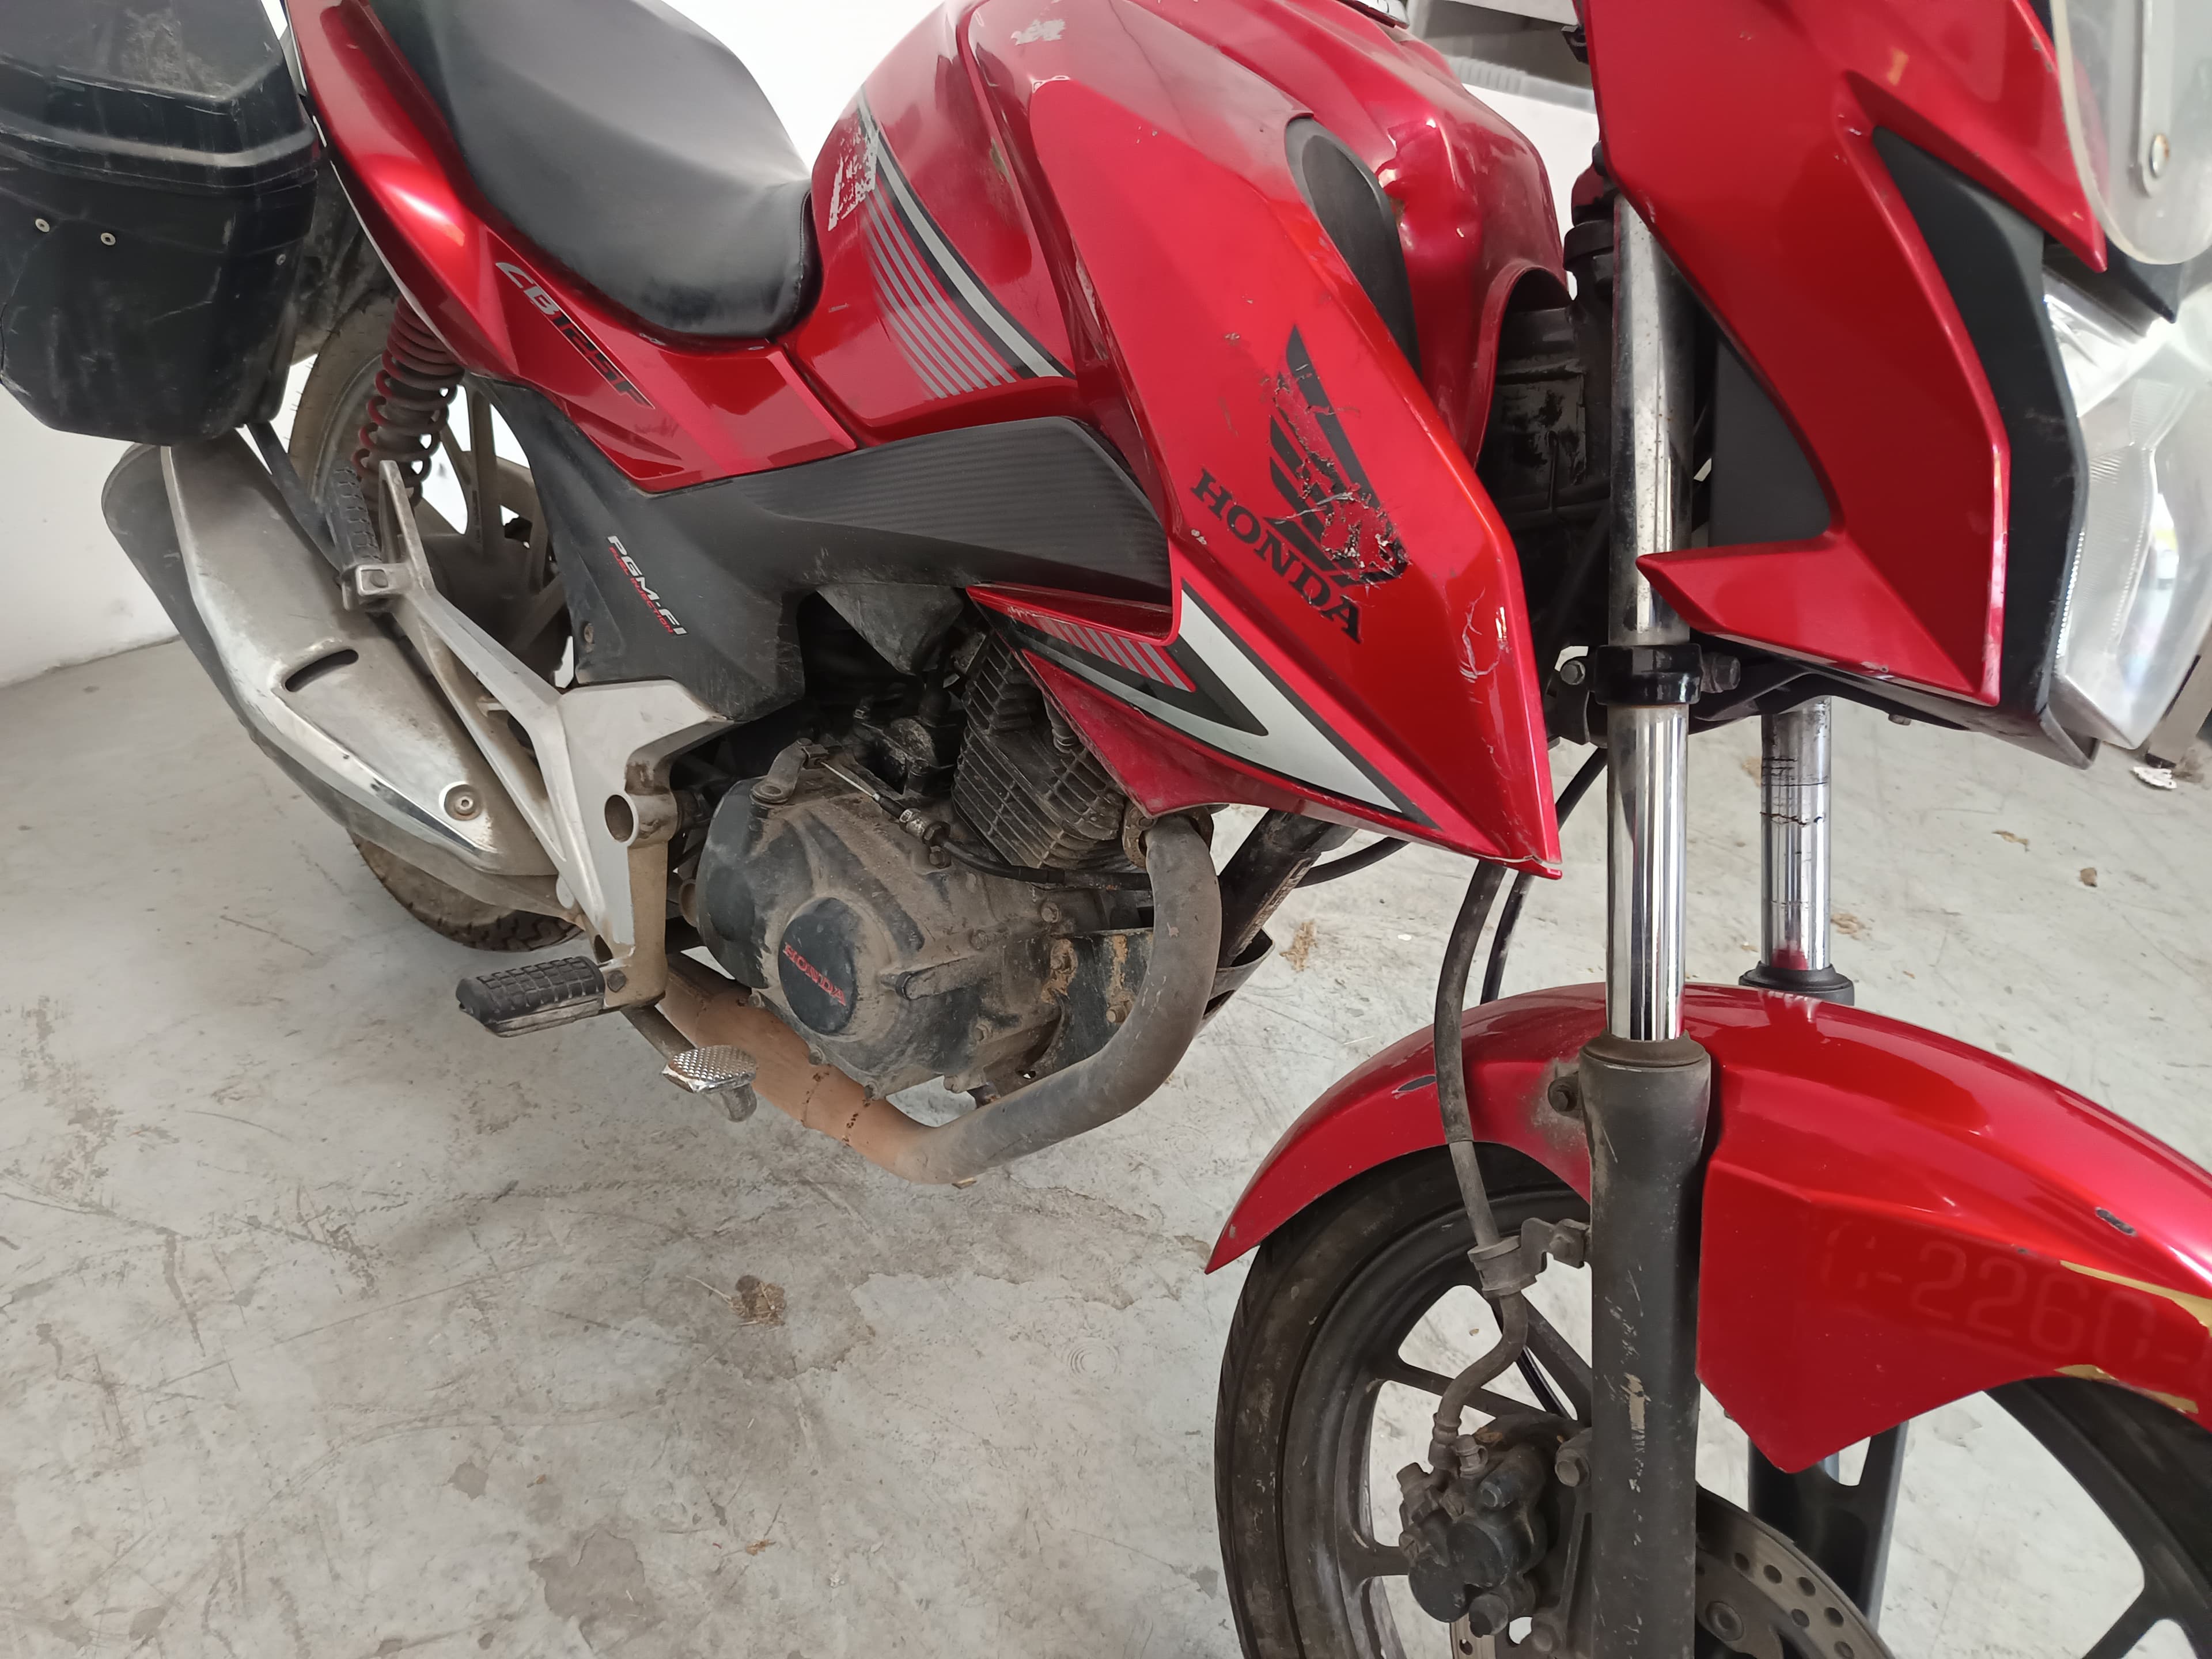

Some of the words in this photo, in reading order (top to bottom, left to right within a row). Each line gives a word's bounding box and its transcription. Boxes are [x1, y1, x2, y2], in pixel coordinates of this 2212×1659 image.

[495, 262, 655, 409] CB125F
[609, 546, 629, 576] FUEL
[630, 577, 673, 634] INJECTION
[1190, 468, 1361, 644] HONDA
[782, 941, 846, 1006] HONDA
